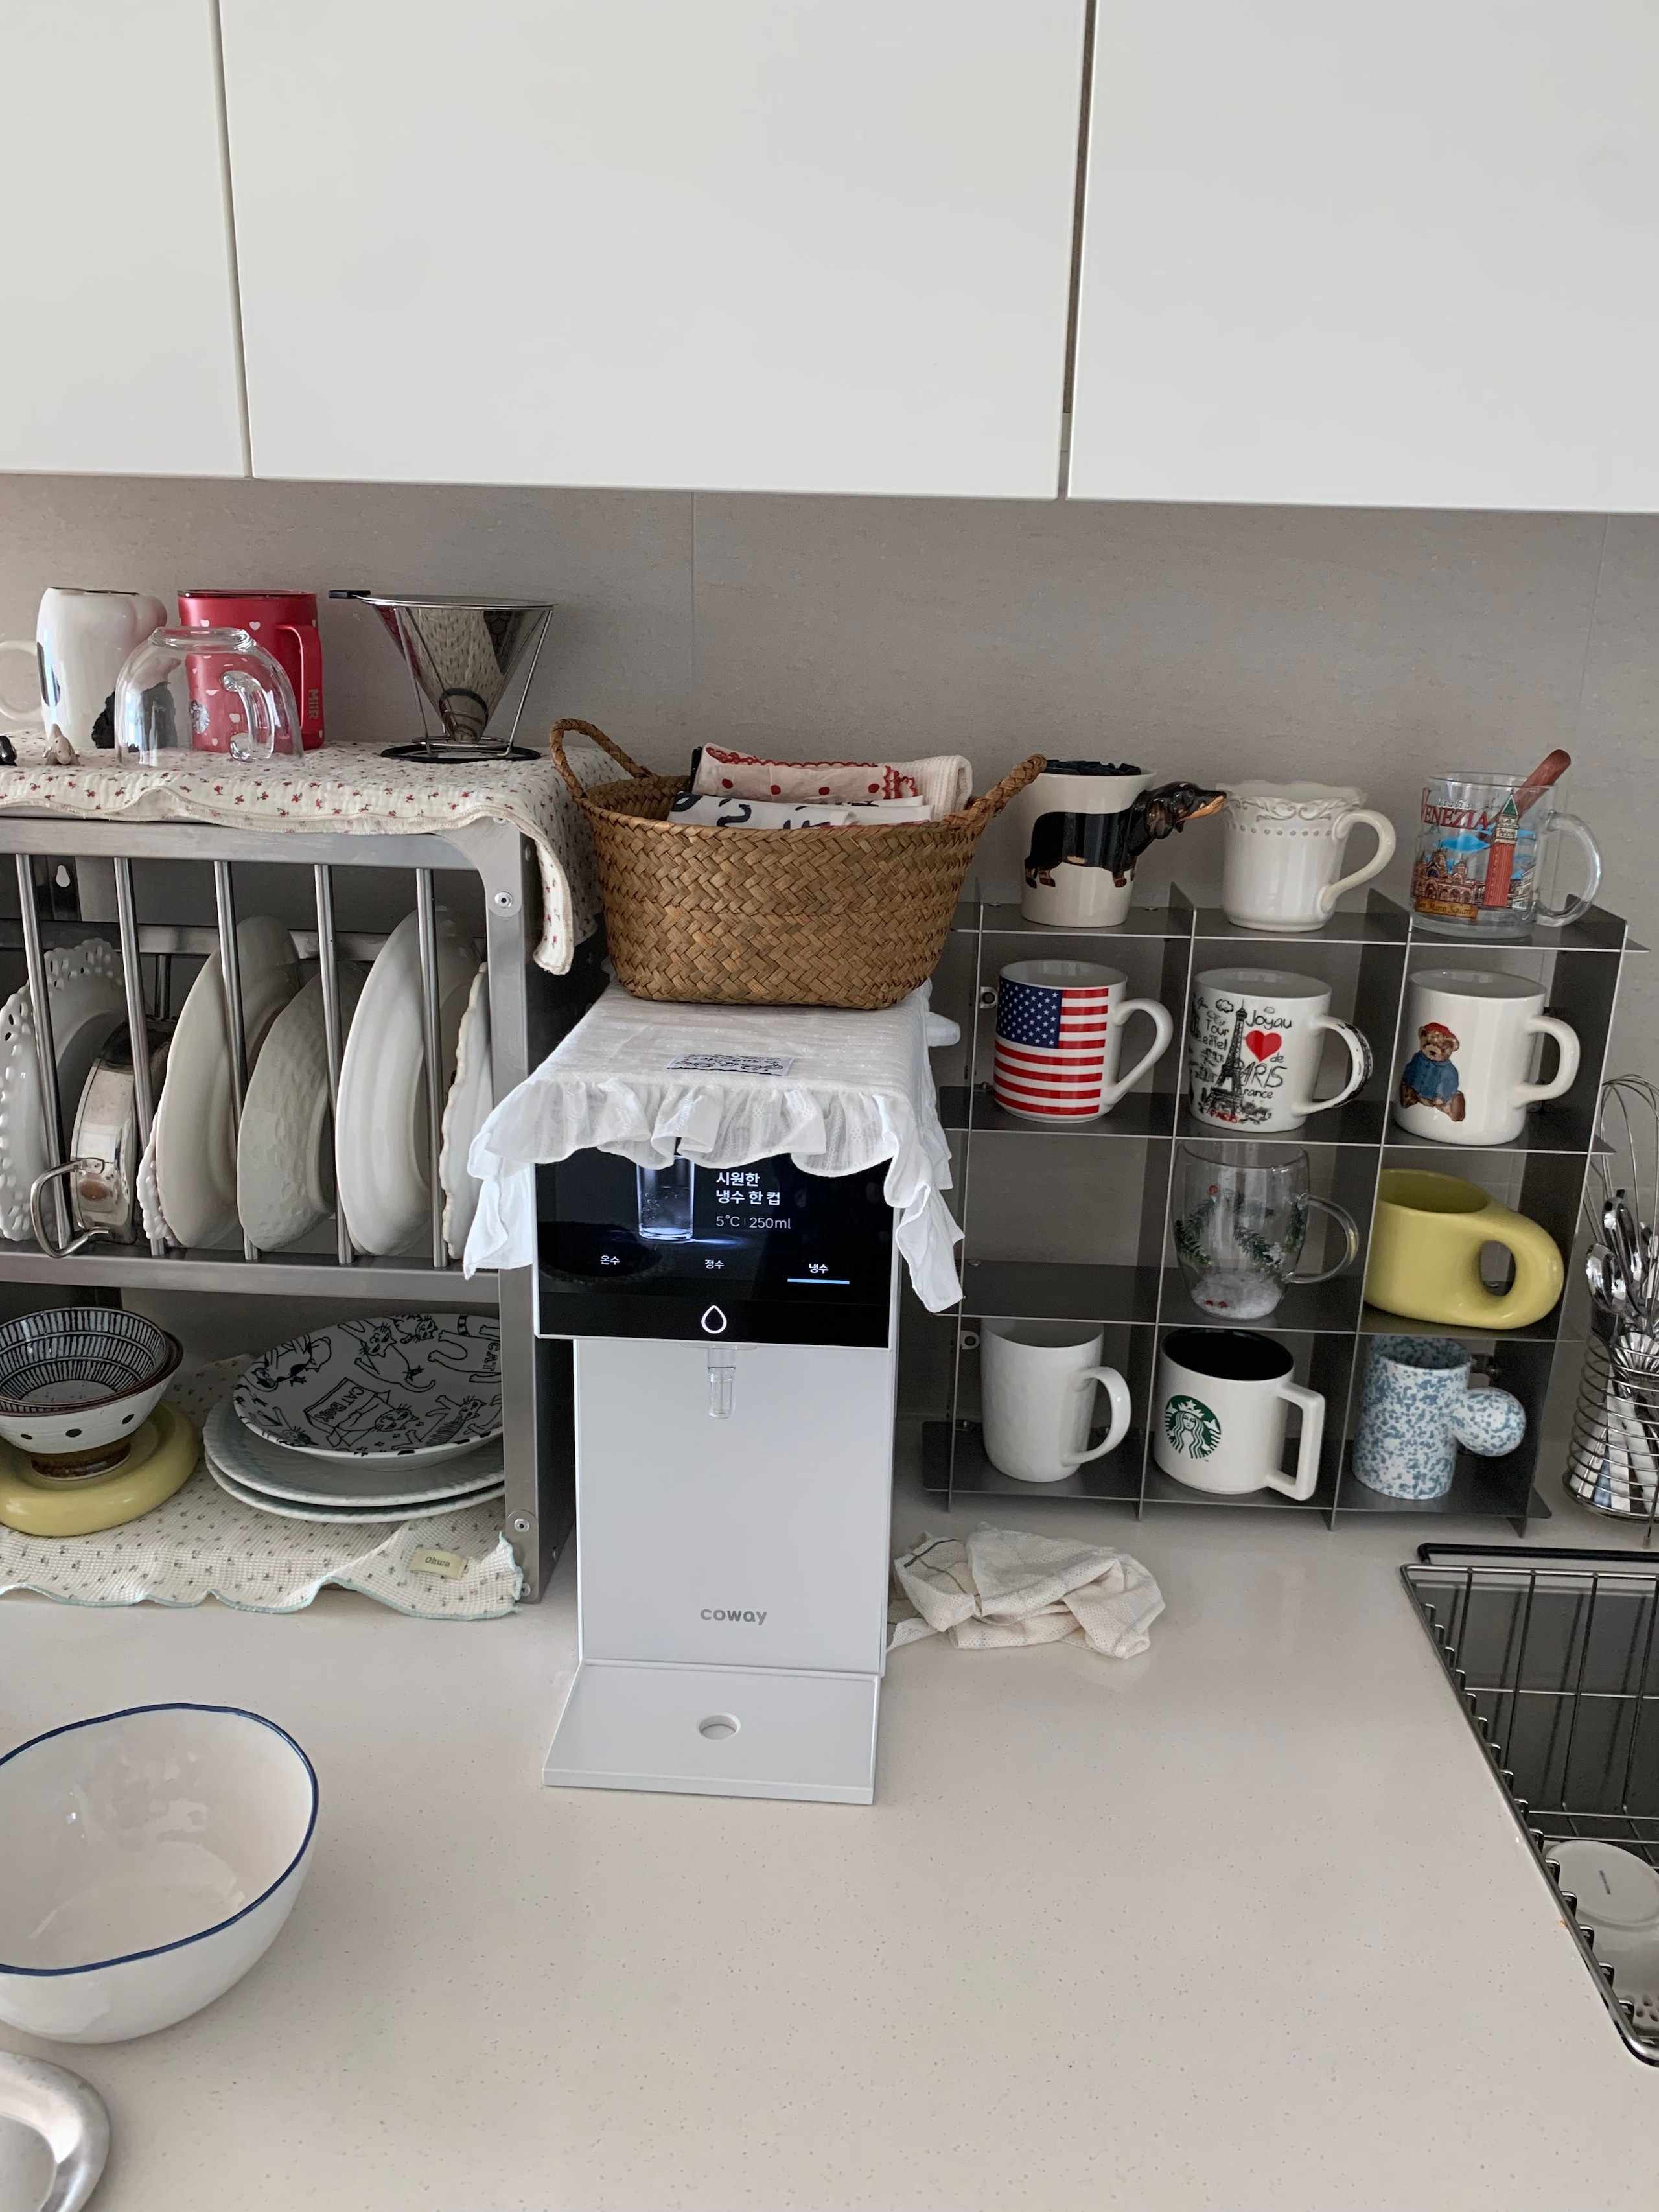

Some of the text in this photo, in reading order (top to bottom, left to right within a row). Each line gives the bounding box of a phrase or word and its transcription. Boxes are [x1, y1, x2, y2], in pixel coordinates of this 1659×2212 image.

[1421, 787, 1490, 831] VENEZIA
[1206, 1019, 1229, 1036] Tour
[1246, 1010, 1292, 1030] Joyau
[1270, 1052, 1284, 1064] de
[715, 1171, 760, 1187] 시원한
[715, 1189, 780, 1205] 냉수 한 컵
[749, 1217, 791, 1229] 250ml
[600, 1255, 620, 1266] 온수
[704, 1259, 725, 1270] 정수
[809, 1263, 829, 1274] 냉수
[482, 1342, 501, 1371] CAT
[314, 1386, 365, 1422] CAT BOX
[700, 1609, 767, 1625] coway
